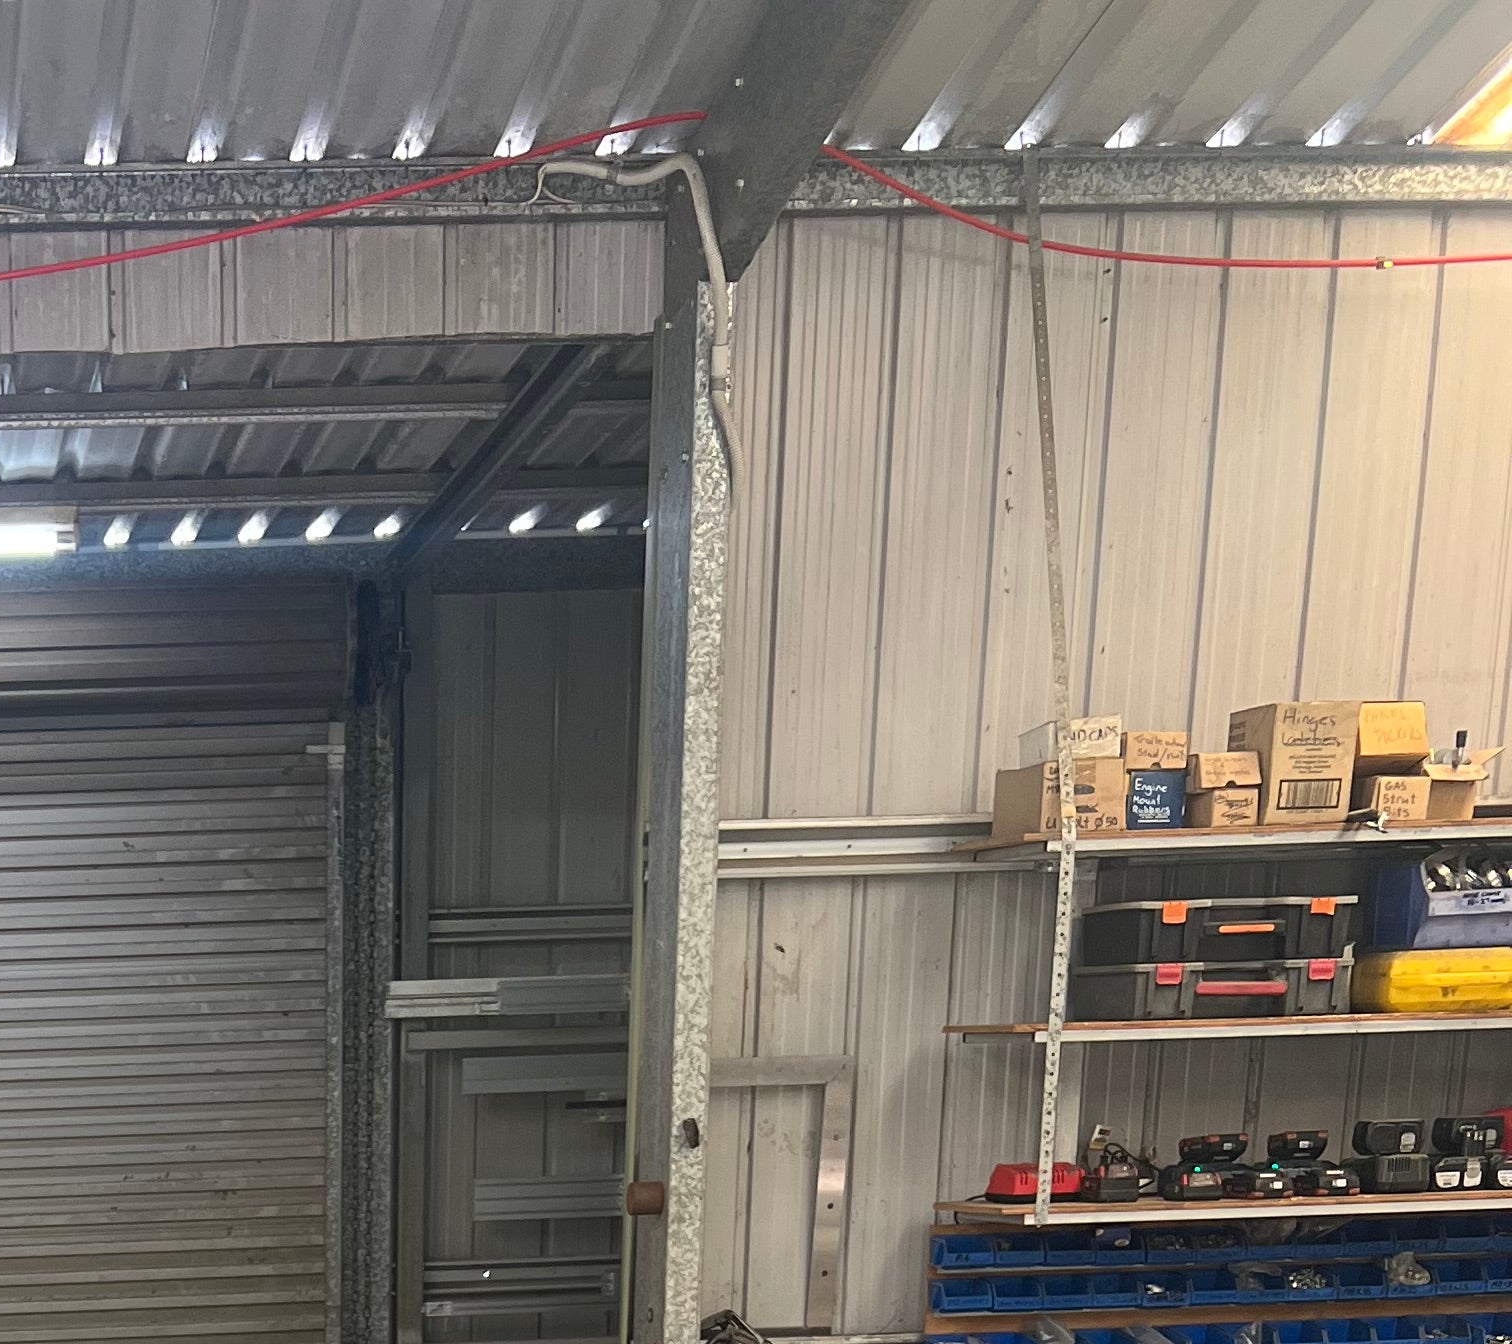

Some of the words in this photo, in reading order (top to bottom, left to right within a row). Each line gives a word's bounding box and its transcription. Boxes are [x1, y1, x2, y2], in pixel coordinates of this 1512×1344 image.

[1283, 708, 1336, 733] Hinges
[1134, 778, 1168, 796] Engine
[1384, 780, 1407, 791] GAS
[1133, 795, 1161, 805] Mount
[1383, 793, 1416, 805] Strut
[1132, 805, 1171, 816] Rubbers
